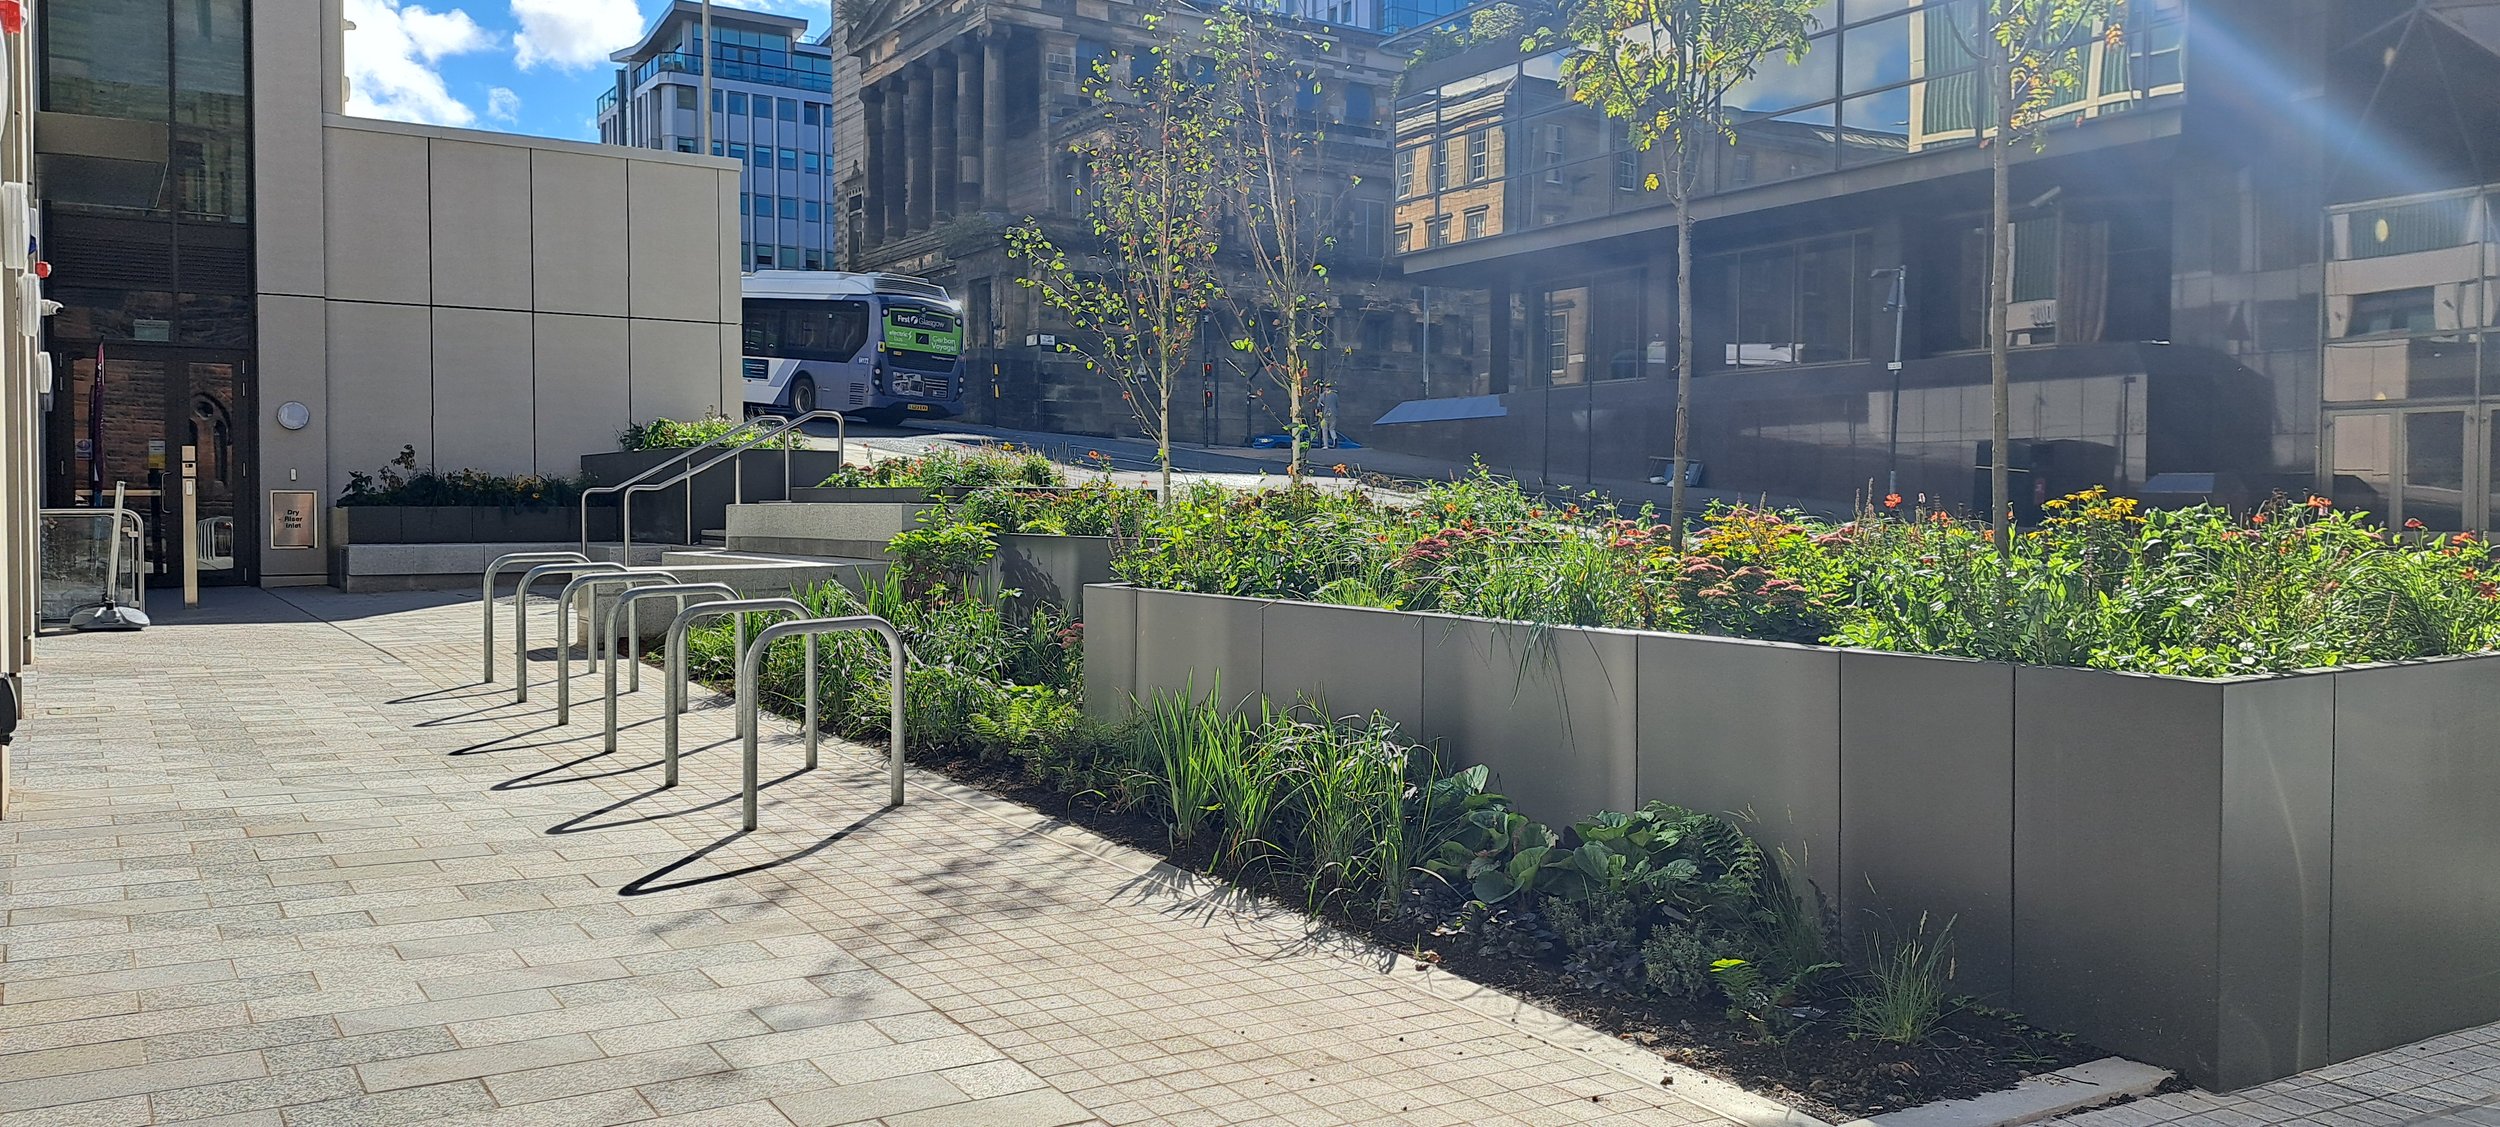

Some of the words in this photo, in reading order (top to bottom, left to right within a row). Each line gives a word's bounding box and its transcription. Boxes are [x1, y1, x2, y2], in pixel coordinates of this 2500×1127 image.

[897, 314, 910, 323] First
[918, 317, 945, 328] Glasgow
[931, 335, 956, 344] Carbon
